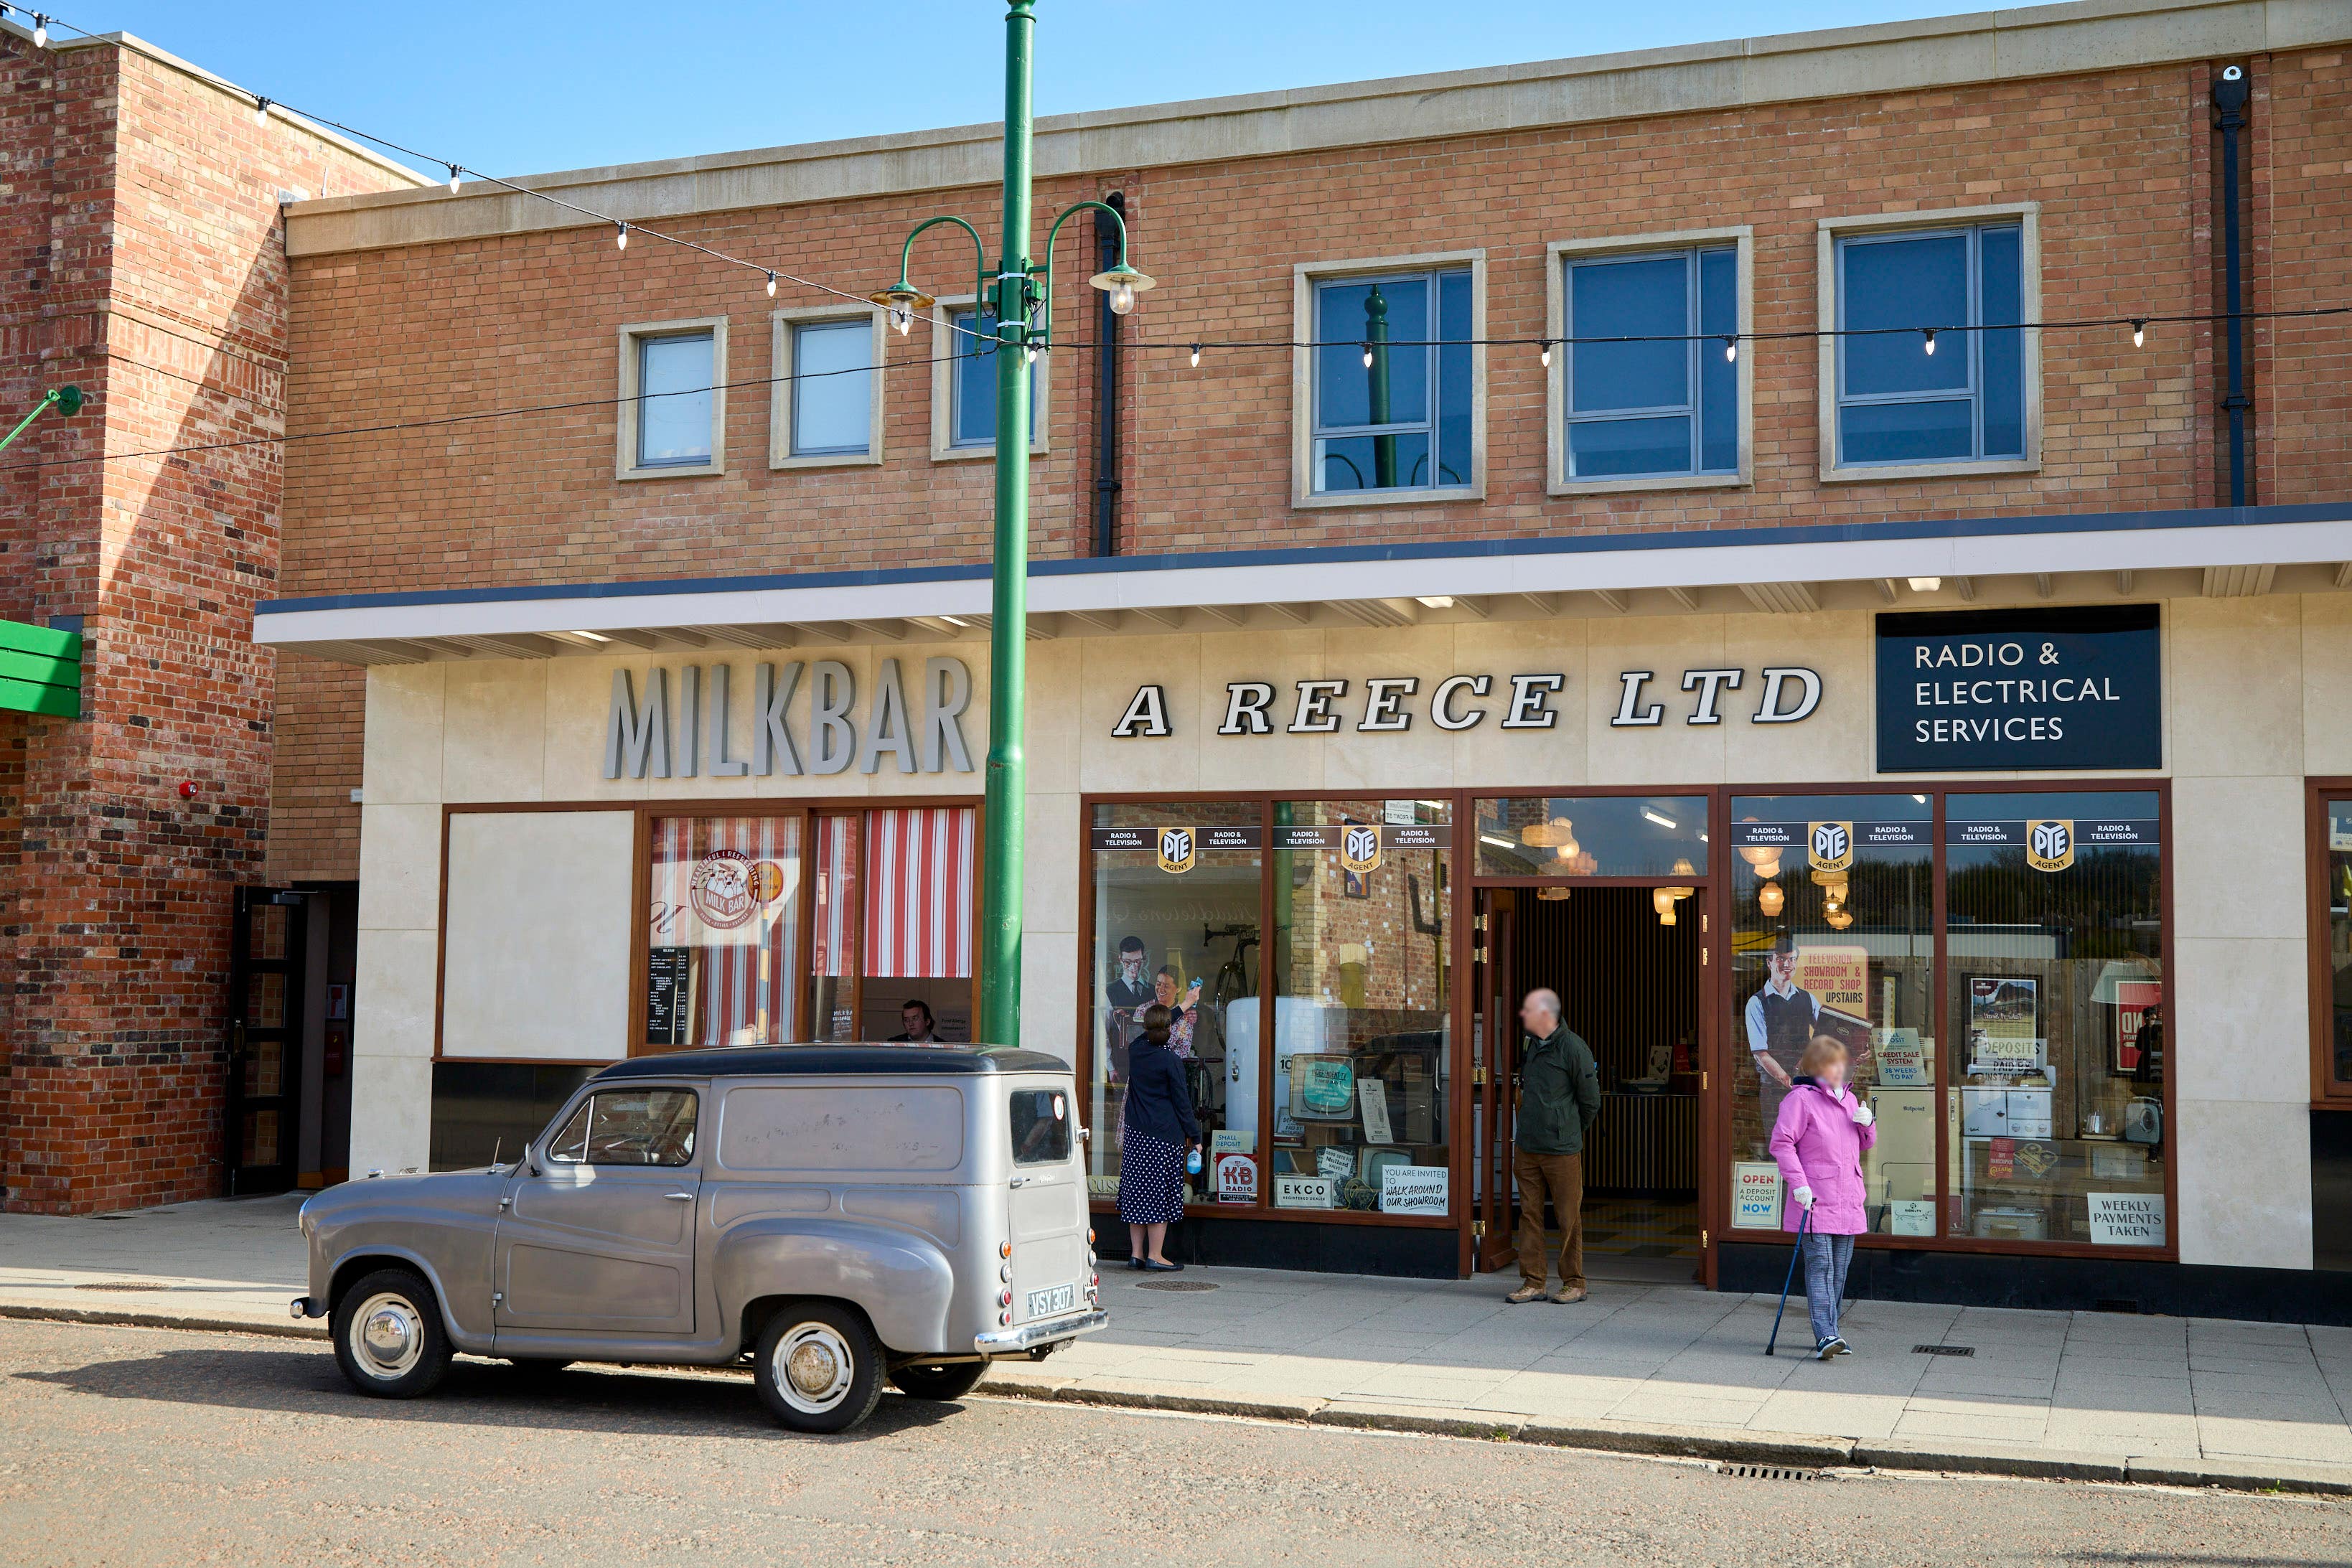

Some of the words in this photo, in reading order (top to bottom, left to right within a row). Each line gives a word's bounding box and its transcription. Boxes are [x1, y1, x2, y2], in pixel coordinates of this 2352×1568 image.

[1916, 642, 2023, 669] RADIO
[2039, 642, 2059, 665] &
[1916, 677, 2120, 705] ELECTRICAL
[1111, 685, 1173, 737] A
[1217, 673, 1565, 735] REECE
[1610, 667, 1823, 728] LTD
[603, 656, 975, 779] MILKBAR
[1916, 717, 2063, 743] SERVICES
[1163, 831, 1189, 862] PYE
[1348, 829, 1374, 861] PYE
[1815, 825, 1845, 860] PYE
[2035, 824, 2066, 860] PYE
[691, 851, 721, 886] HEALTHFUL
[727, 851, 759, 886] REFRESHING
[1163, 863, 1188, 871] AGENT
[1348, 862, 1374, 870] AGENT
[1816, 860, 1845, 869] AGENT
[2035, 860, 2065, 869] AGENT
[706, 891, 726, 912] MILK
[728, 895, 744, 914] BAR
[1809, 953, 1852, 964] TELEVISION
[1804, 966, 1847, 977] SHOWROOM
[1855, 966, 1861, 977] &
[1804, 979, 1834, 990] RECORD
[1840, 979, 1861, 990] SHOP
[1826, 992, 1863, 1003] UPSTAIRS
[1986, 1042, 2041, 1055] DEPOSITS
[1993, 1061, 2014, 1071] PAID
[2018, 1061, 2031, 1072] BY
[1326, 1156, 1349, 1167] Mullard
[1223, 1167, 1253, 1185] KB
[1743, 1175, 1774, 1184] OPEN
[1284, 1185, 1324, 1195] EKCO
[1386, 1185, 1407, 1196] WALK
[1408, 1184, 1443, 1195] AROUND
[1386, 1197, 1402, 1206] OUR
[1403, 1196, 1446, 1208] SHOWROOM
[2102, 1201, 2150, 1211] WEEKLY
[1743, 1203, 1772, 1213] NOW
[2094, 1213, 2162, 1224] PAYMENTS
[2107, 1226, 2150, 1236] TAKEN
[1031, 1291, 1052, 1315] VSY
[1052, 1286, 1071, 1310] 307
